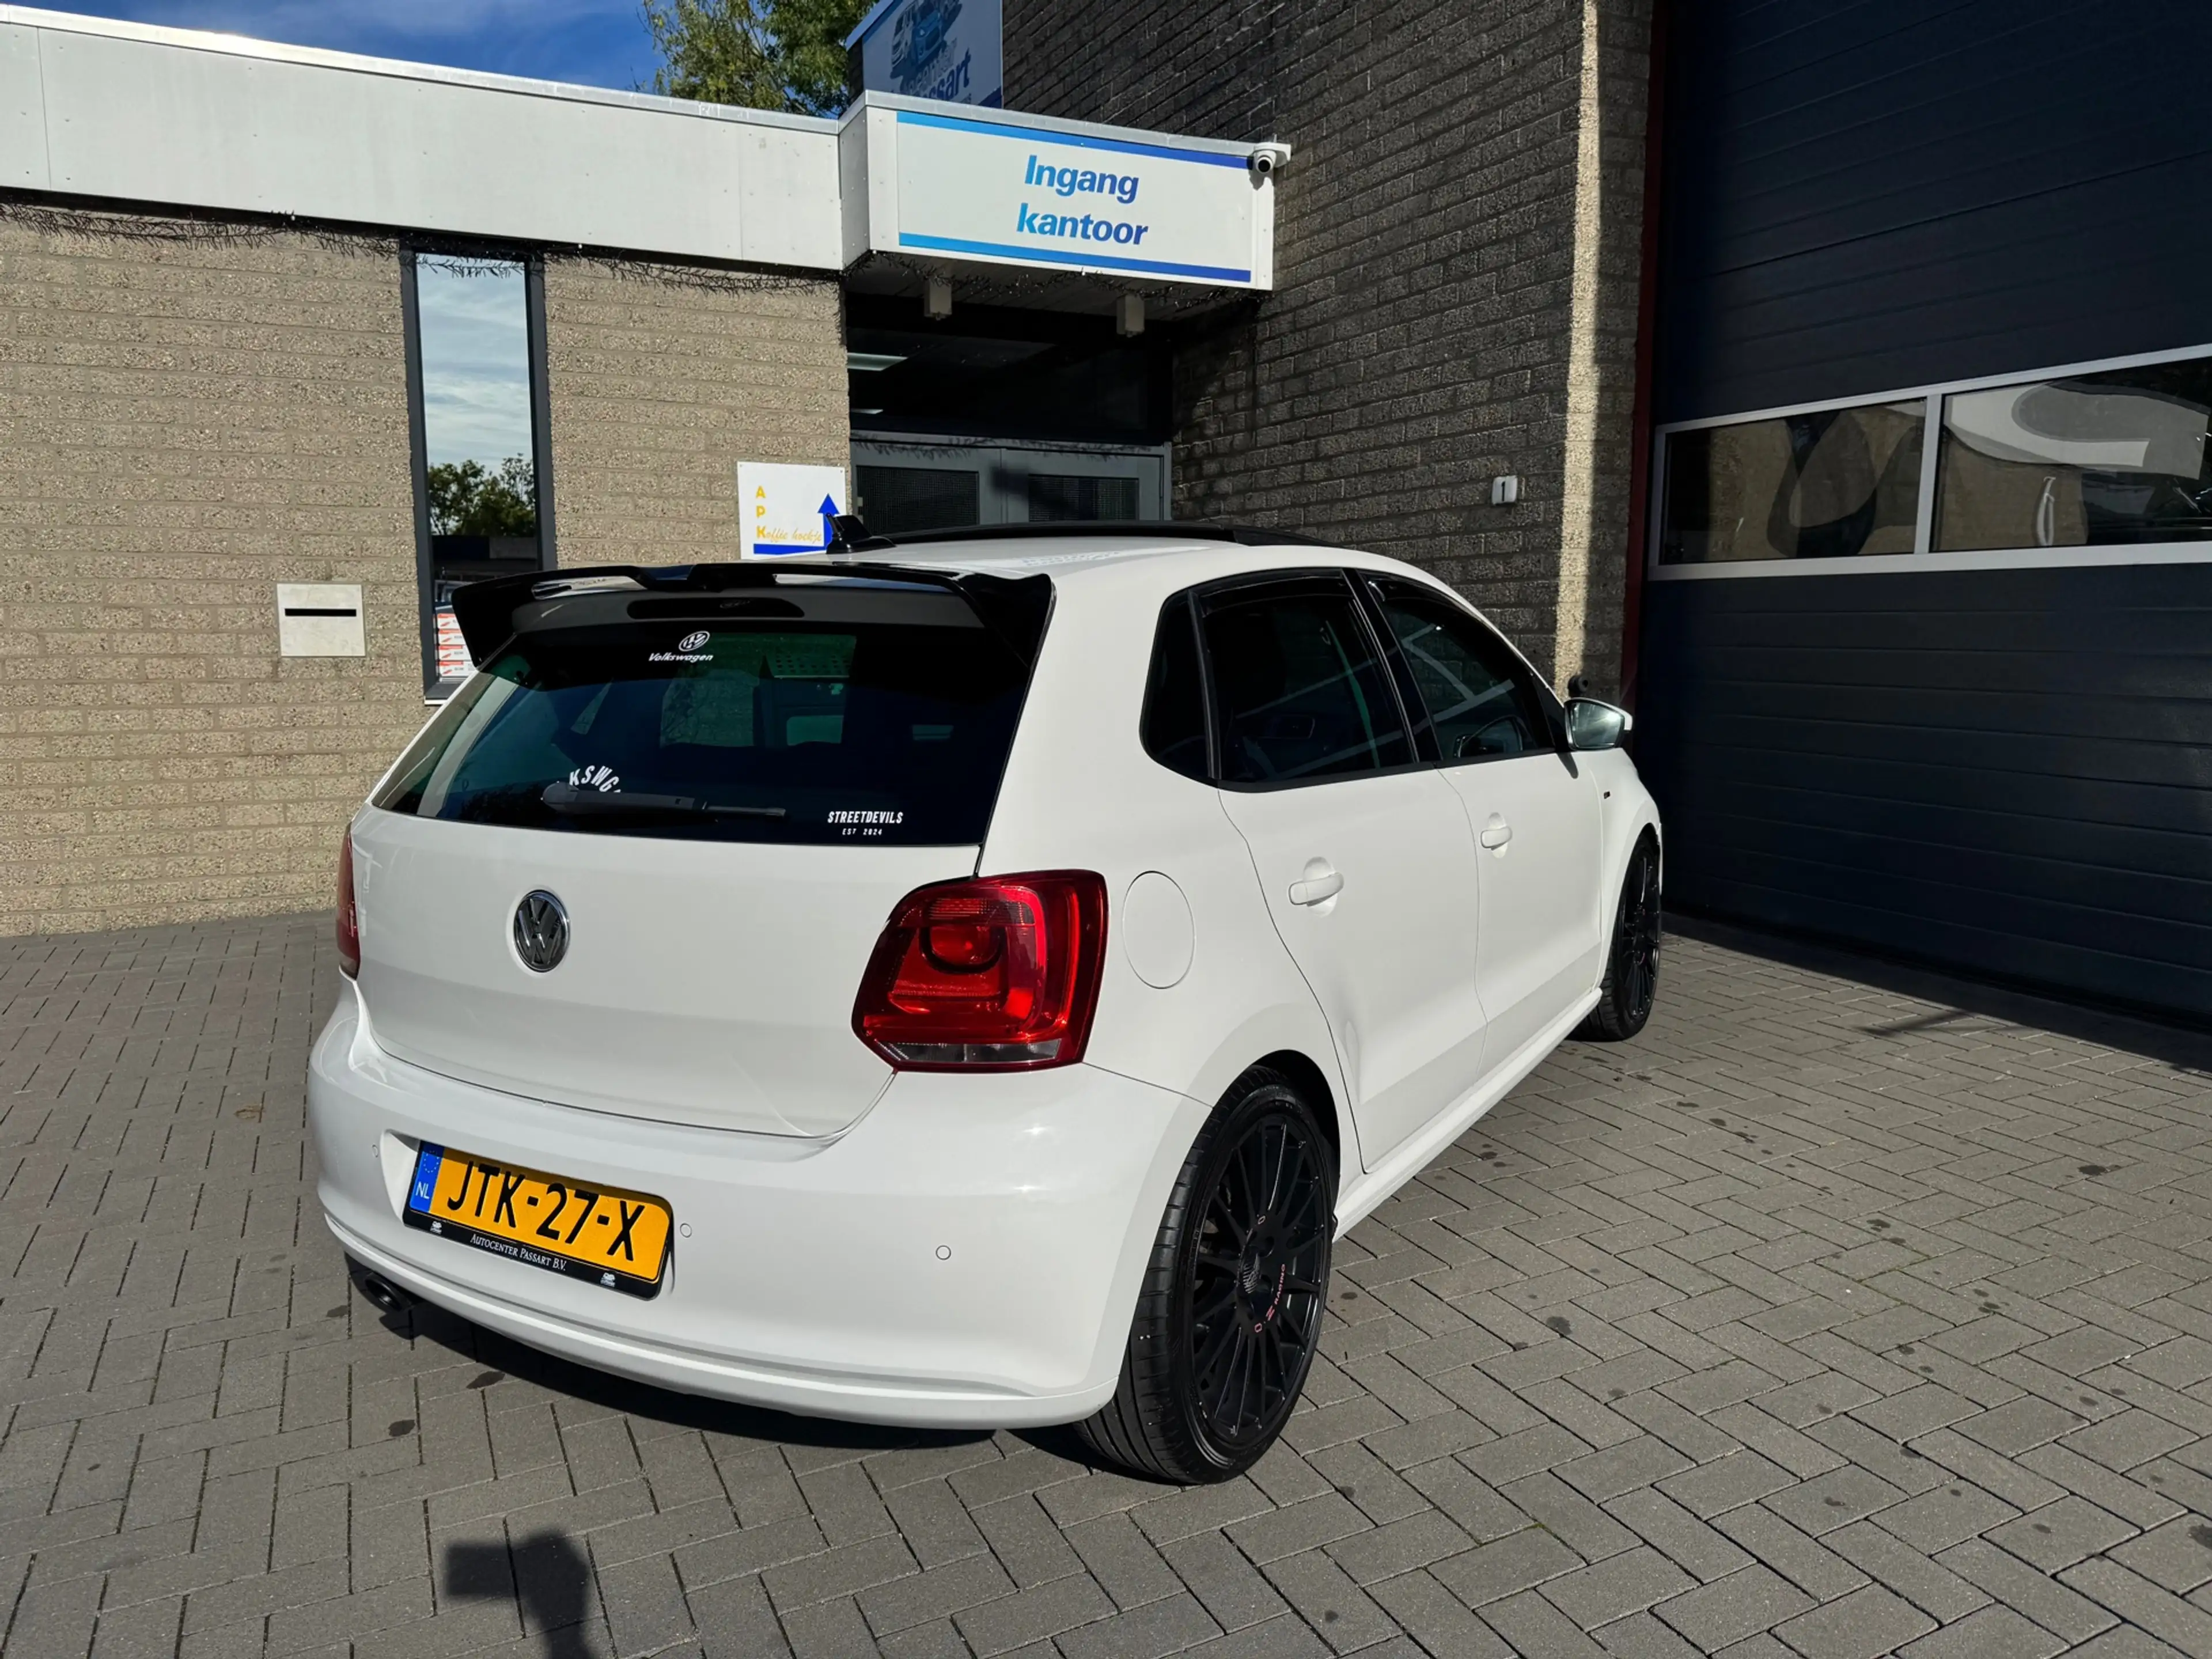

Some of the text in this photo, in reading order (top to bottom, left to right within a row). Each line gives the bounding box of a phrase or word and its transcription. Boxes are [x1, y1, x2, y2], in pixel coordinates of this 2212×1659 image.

[1024, 154, 1139, 204] Ingang
[1016, 202, 1149, 245] kantoor
[649, 652, 714, 663] Volkswagen
[569, 765, 621, 793] KSWG
[827, 811, 903, 824] STREETDEVILS
[415, 1181, 431, 1199] NL
[447, 1161, 645, 1262] JTK-27-X
[520, 1249, 551, 1267] PASSART
[553, 1258, 567, 1271] B.V.
